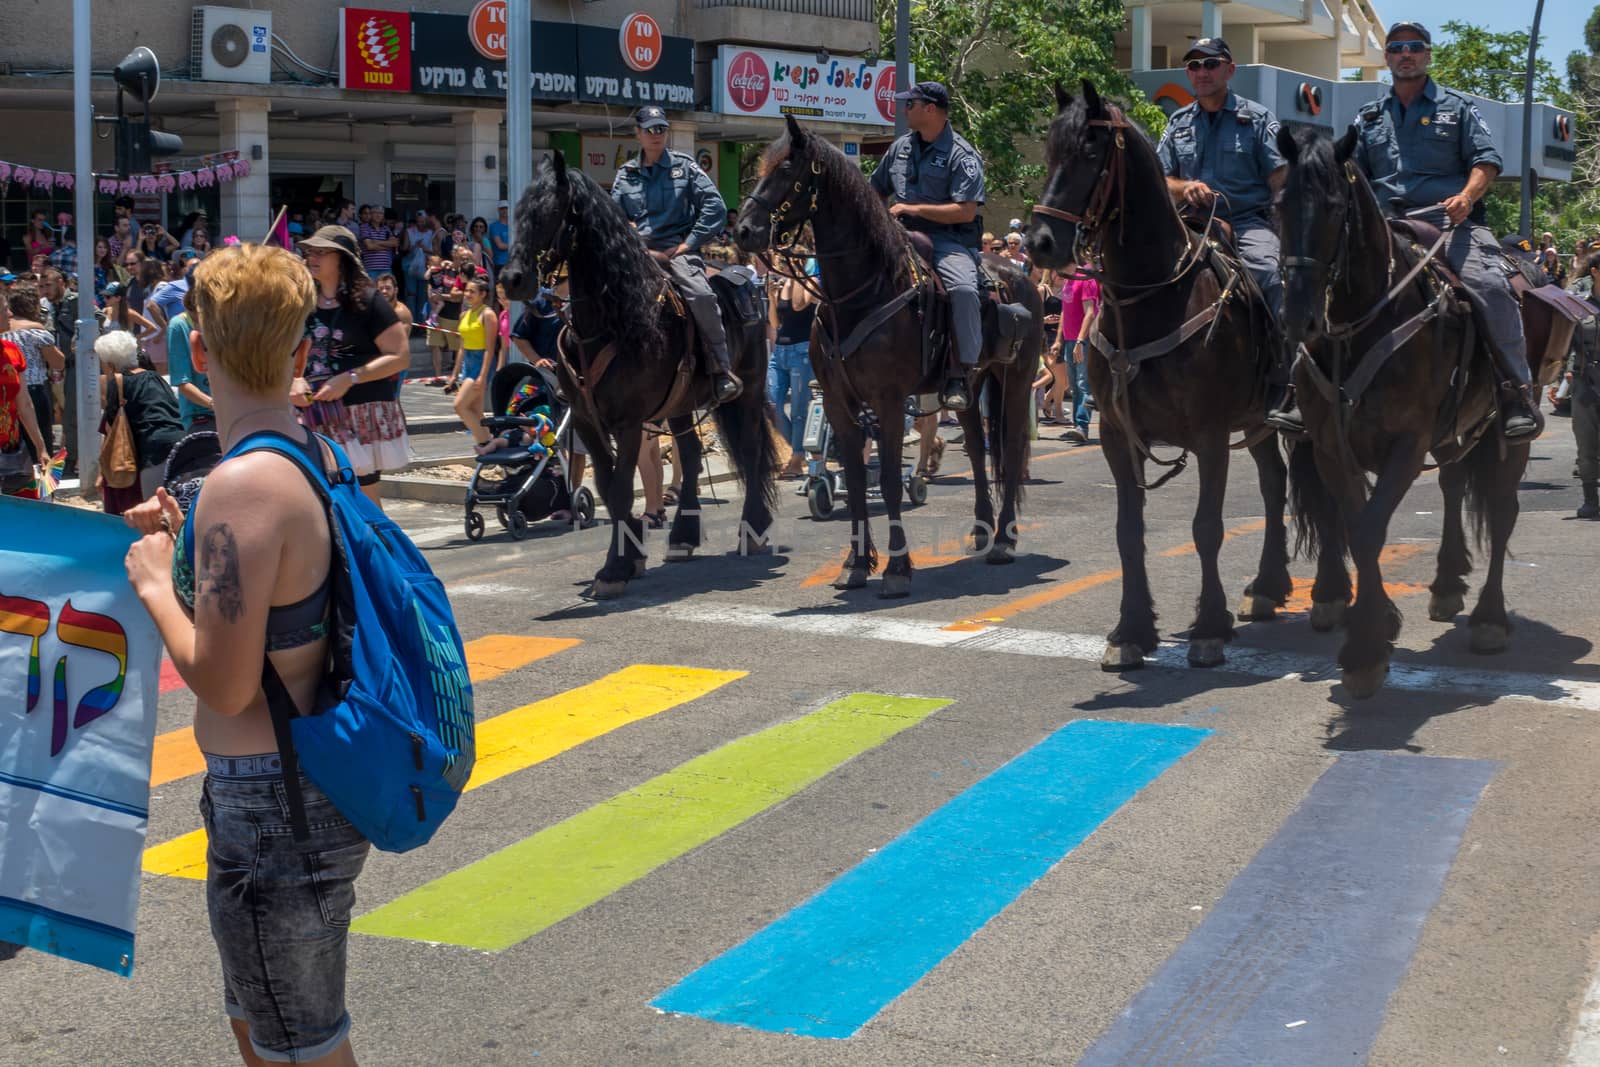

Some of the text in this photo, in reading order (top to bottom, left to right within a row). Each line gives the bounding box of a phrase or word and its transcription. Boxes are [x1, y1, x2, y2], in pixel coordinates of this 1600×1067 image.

[634, 20, 653, 38] TO
[634, 46, 653, 62] GO
[364, 71, 394, 85] טוטו
[419, 66, 466, 89] מרקט
[472, 66, 486, 89] &
[826, 60, 873, 91] פלאפל
[585, 76, 694, 104] אספרסו בר & מרקט
[772, 87, 790, 102] כשר
